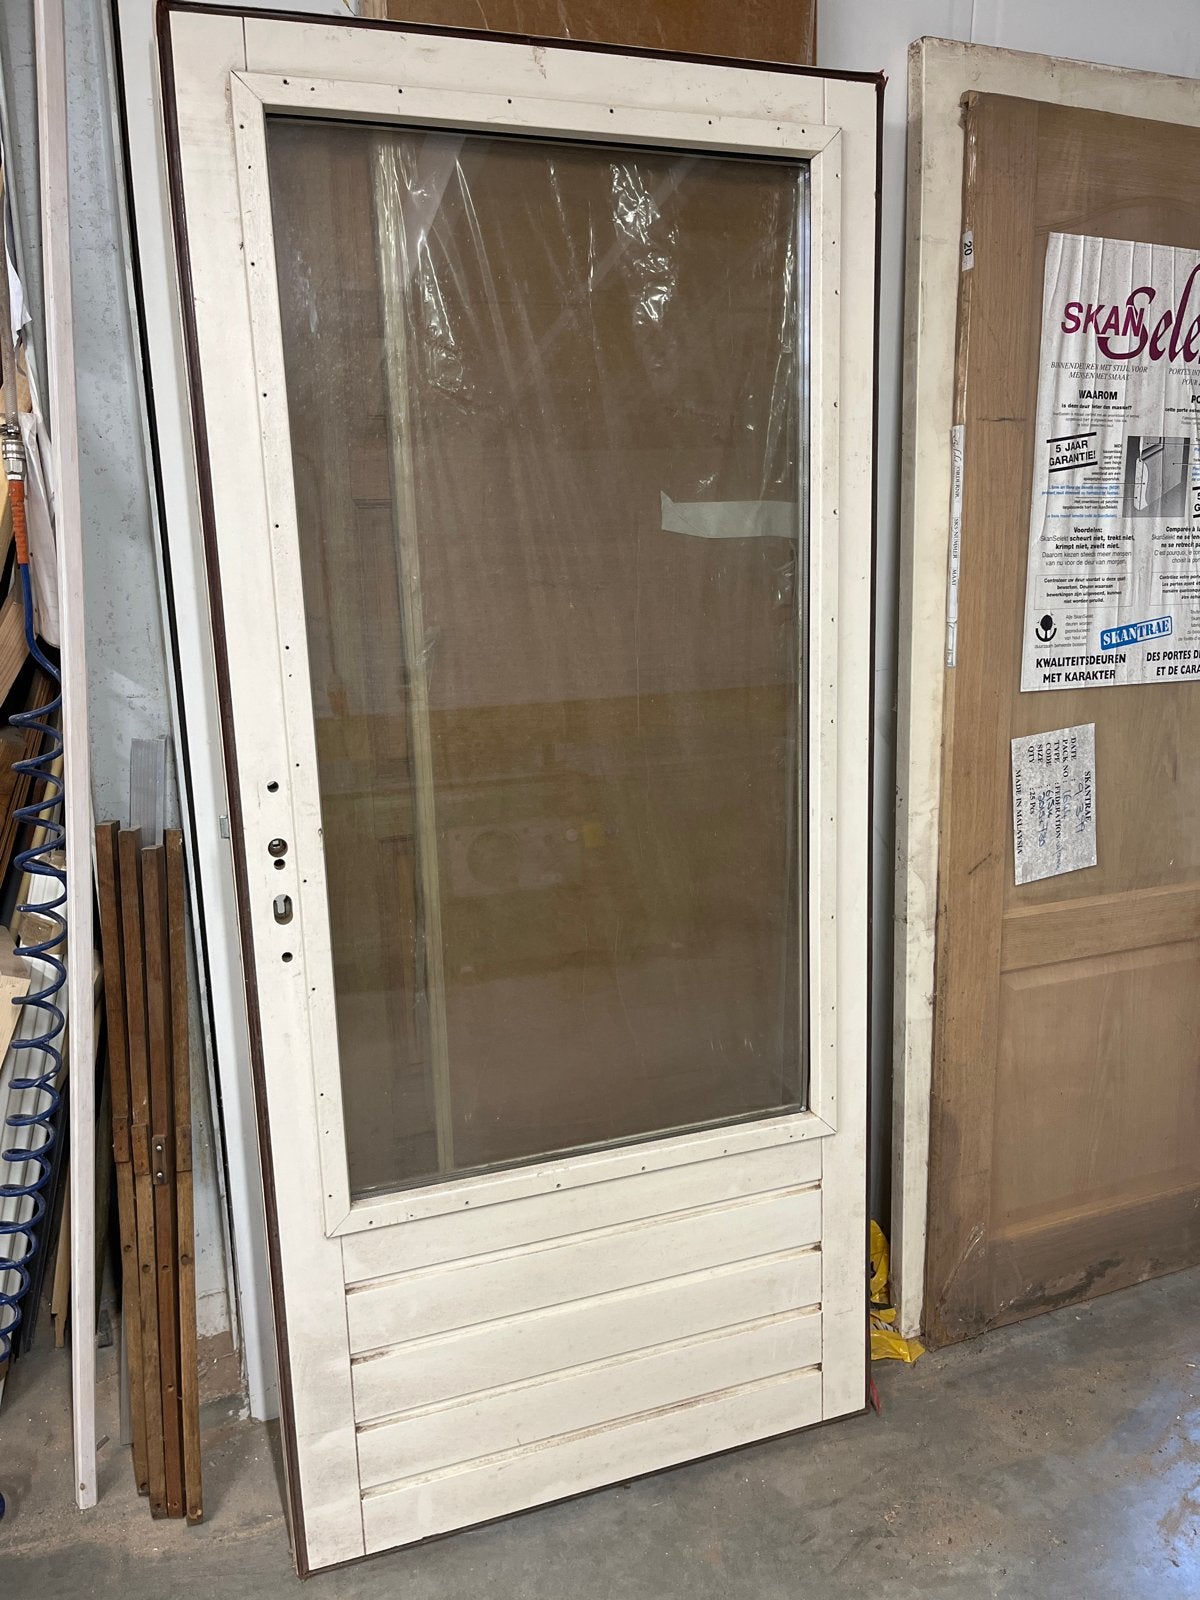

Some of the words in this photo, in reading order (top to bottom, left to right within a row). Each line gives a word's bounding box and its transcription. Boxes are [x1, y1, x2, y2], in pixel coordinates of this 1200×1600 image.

[964, 241, 972, 255] 20
[1079, 390, 1118, 400] WAAROM
[1065, 440, 1088, 451] JAAR
[1049, 450, 1096, 466] GARANTIE!
[1103, 619, 1169, 646] SKANTRAE
[1036, 654, 1126, 668] KWALITEITSDEUREN
[1146, 651, 1160, 661] DES
[1162, 650, 1191, 660] PORTES
[1043, 673, 1062, 683] MET
[1065, 670, 1116, 682] KARAKTER
[1156, 666, 1166, 676] ET
[1168, 665, 1178, 675] DE
[1063, 764, 1069, 777] NO
[1016, 798, 1021, 807] IN
